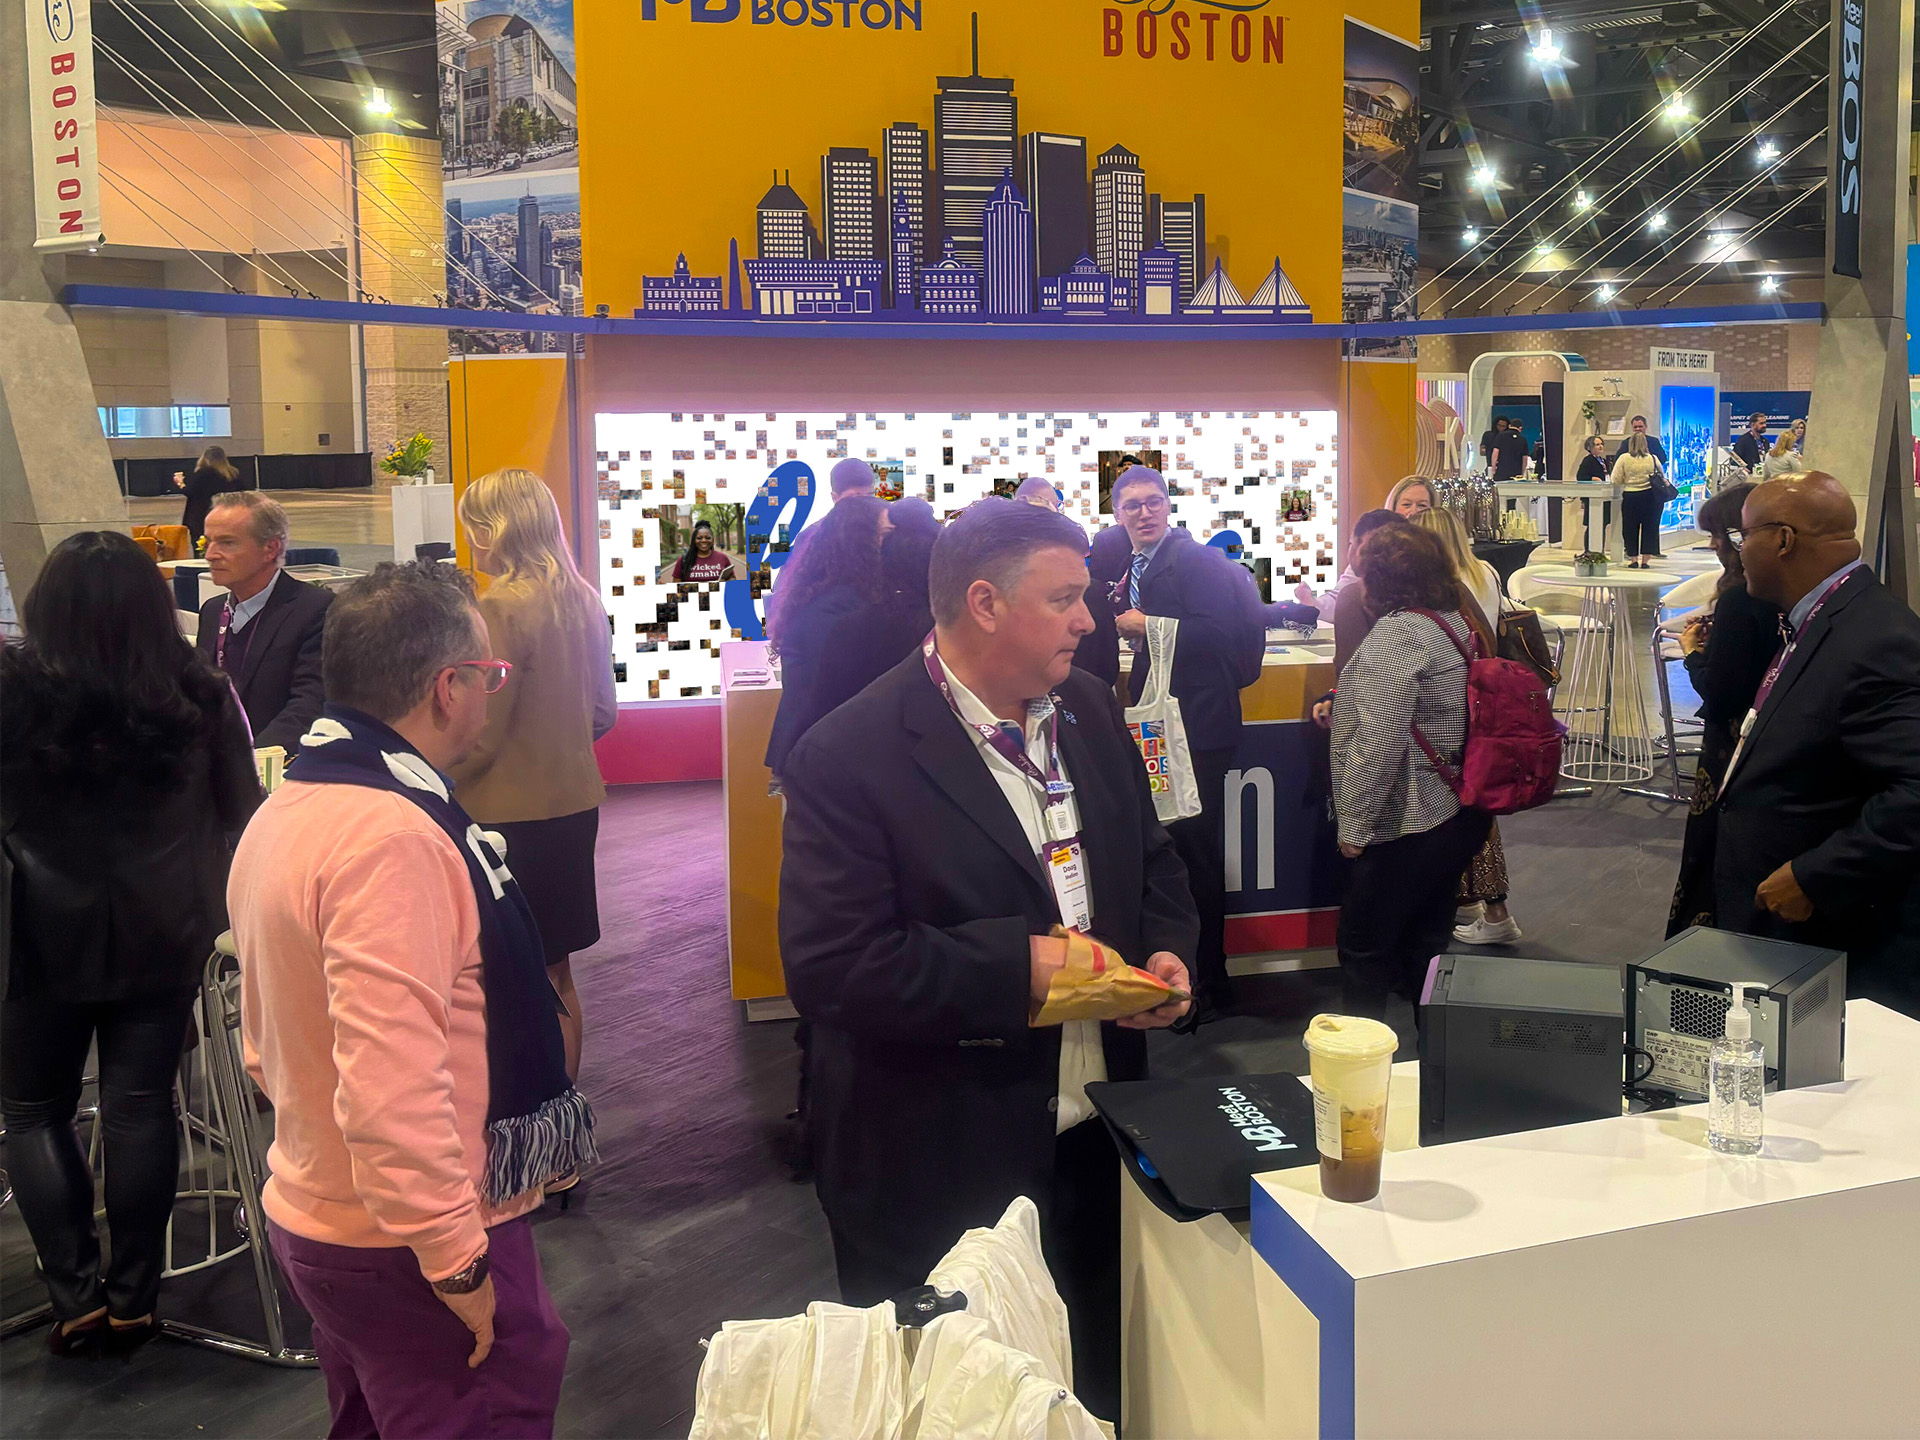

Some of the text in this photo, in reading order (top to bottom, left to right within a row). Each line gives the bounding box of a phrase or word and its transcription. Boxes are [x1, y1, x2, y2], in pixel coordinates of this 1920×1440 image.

[752, 0, 922, 31] BOSTON
[1103, 8, 1284, 64] BOSTON
[51, 52, 84, 234] BOSTON
[1657, 351, 1708, 369] FROM THE HEART
[689, 570, 721, 578] smaht
[1217, 1086, 1273, 1126] BOSTON
